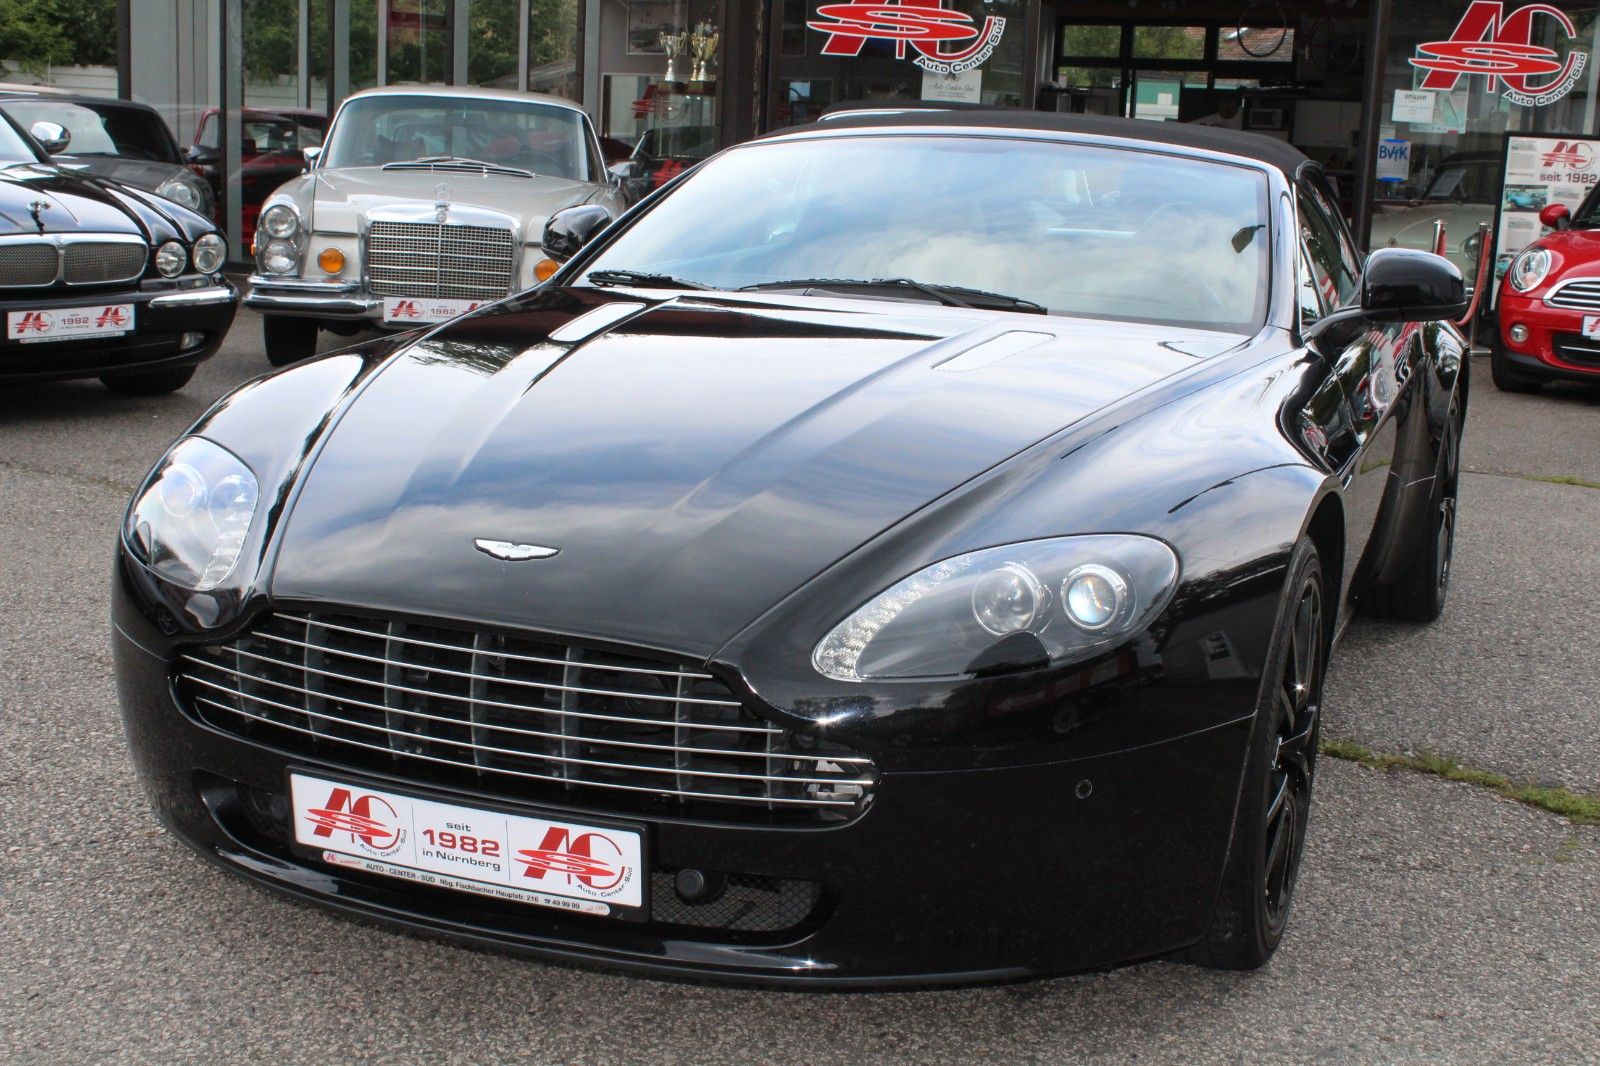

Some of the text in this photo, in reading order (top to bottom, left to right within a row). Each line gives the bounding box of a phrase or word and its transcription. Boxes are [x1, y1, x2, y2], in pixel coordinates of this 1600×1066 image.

[917, 57, 949, 73] Auto
[952, 46, 992, 72] Center
[1404, 93, 1427, 101] amazon
[1505, 91, 1533, 105] Auto
[1537, 80, 1573, 105] Center
[1540, 172, 1597, 184] seit 1982
[61, 317, 89, 325] 1982
[446, 822, 472, 832] seit
[422, 829, 500, 858] 1982
[422, 848, 501, 872] in Nürnberg
[366, 863, 385, 873] AUTO
[389, 867, 416, 879] CENTER
[577, 884, 597, 896] Auto
